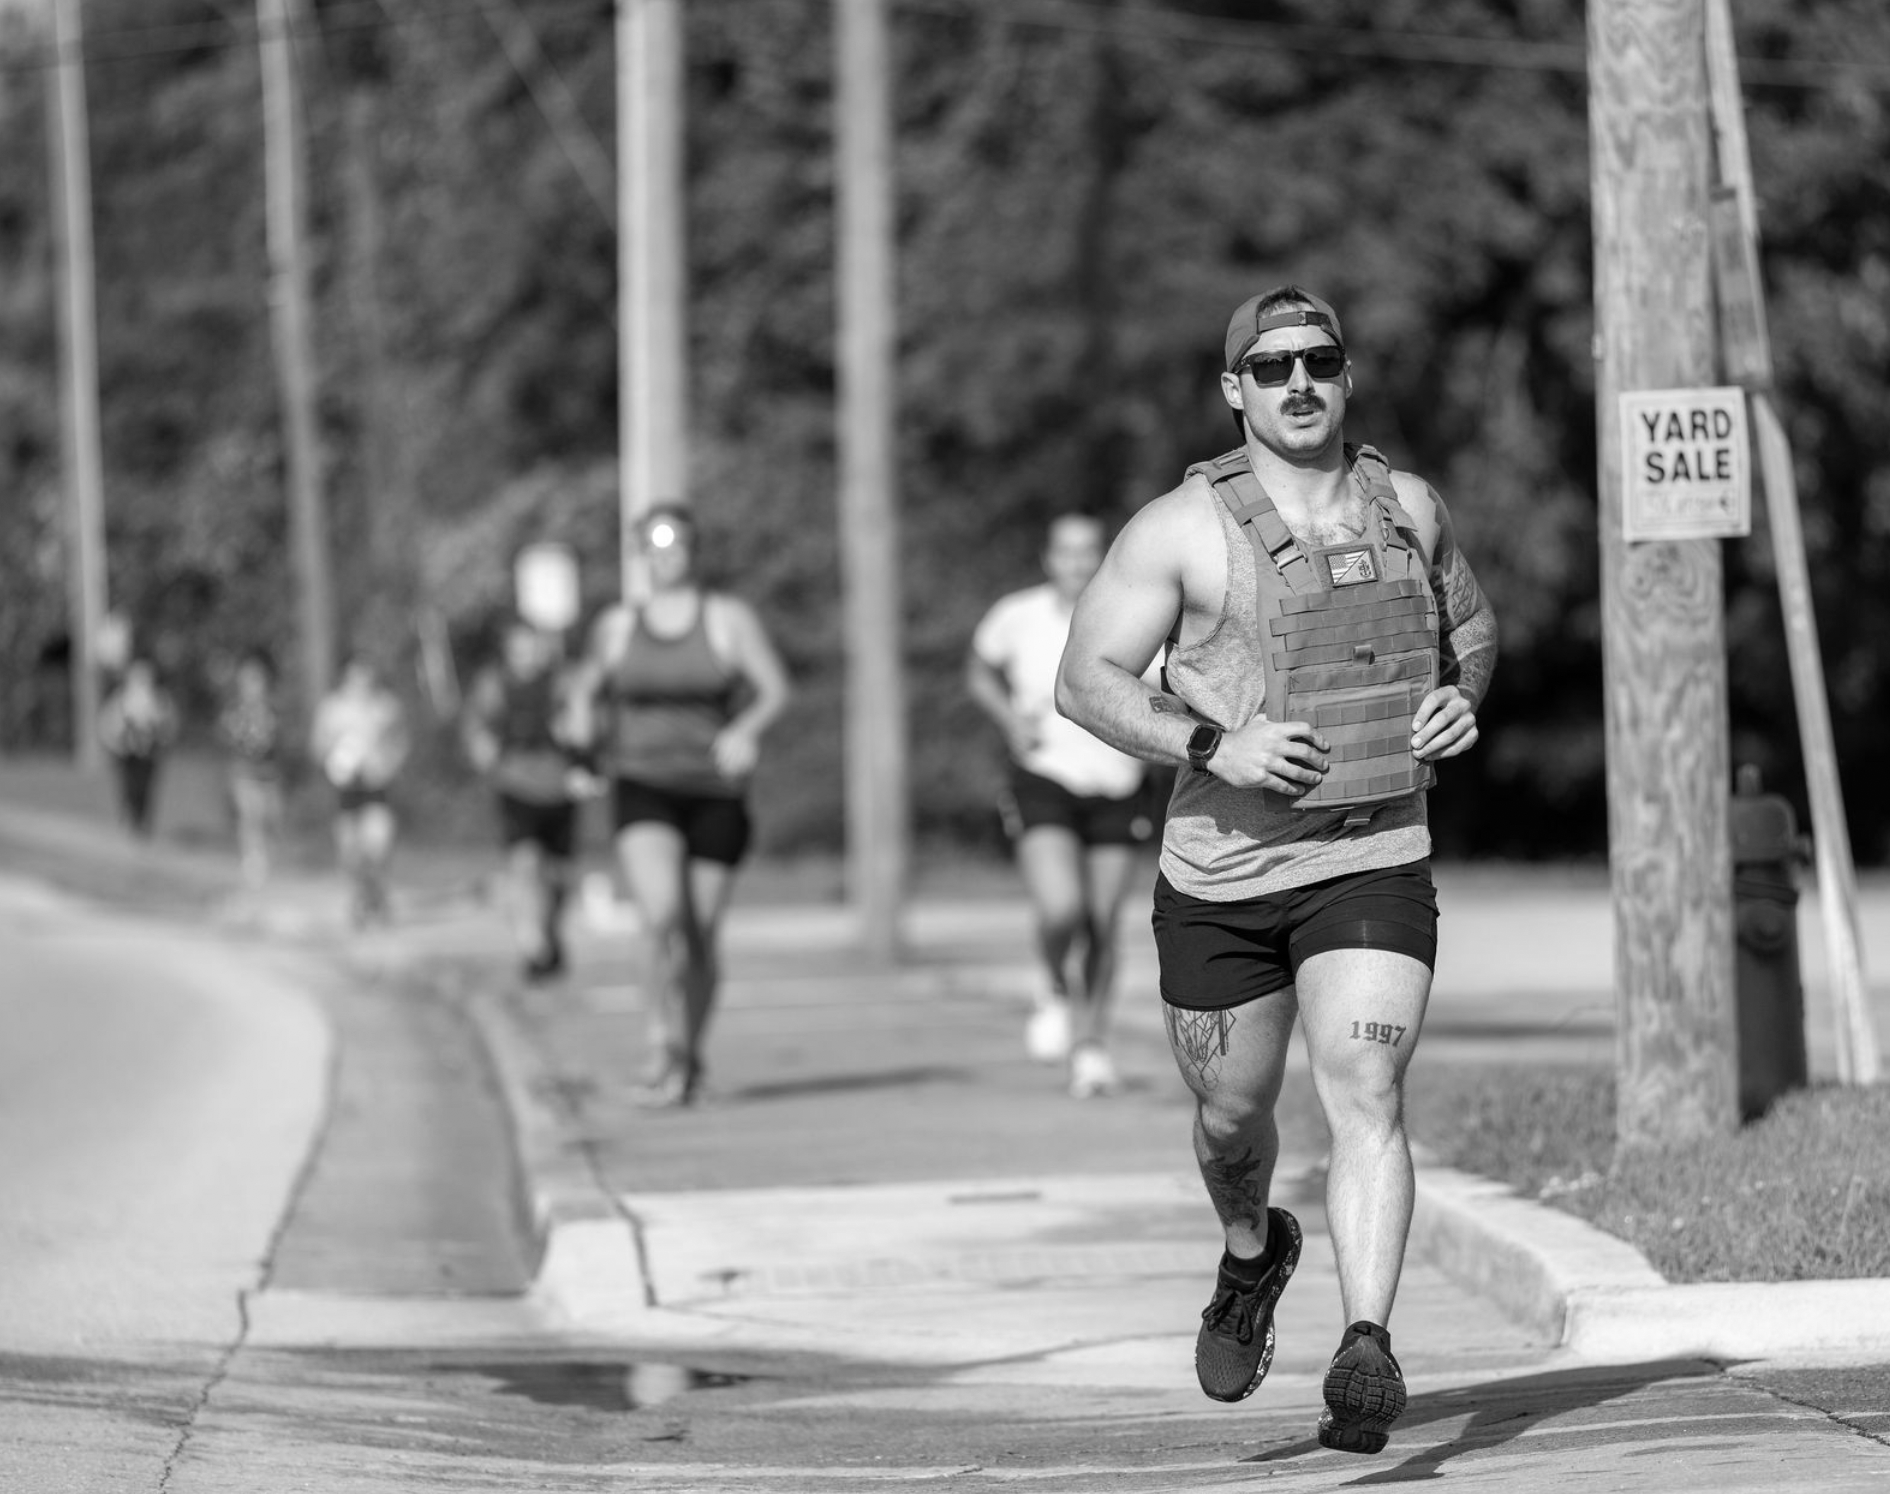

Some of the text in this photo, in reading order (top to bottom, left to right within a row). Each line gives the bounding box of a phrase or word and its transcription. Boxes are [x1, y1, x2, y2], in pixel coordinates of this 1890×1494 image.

[1641, 408, 1732, 442] YARD
[1646, 449, 1731, 483] SALE
[1349, 1020, 1407, 1047] 1997
